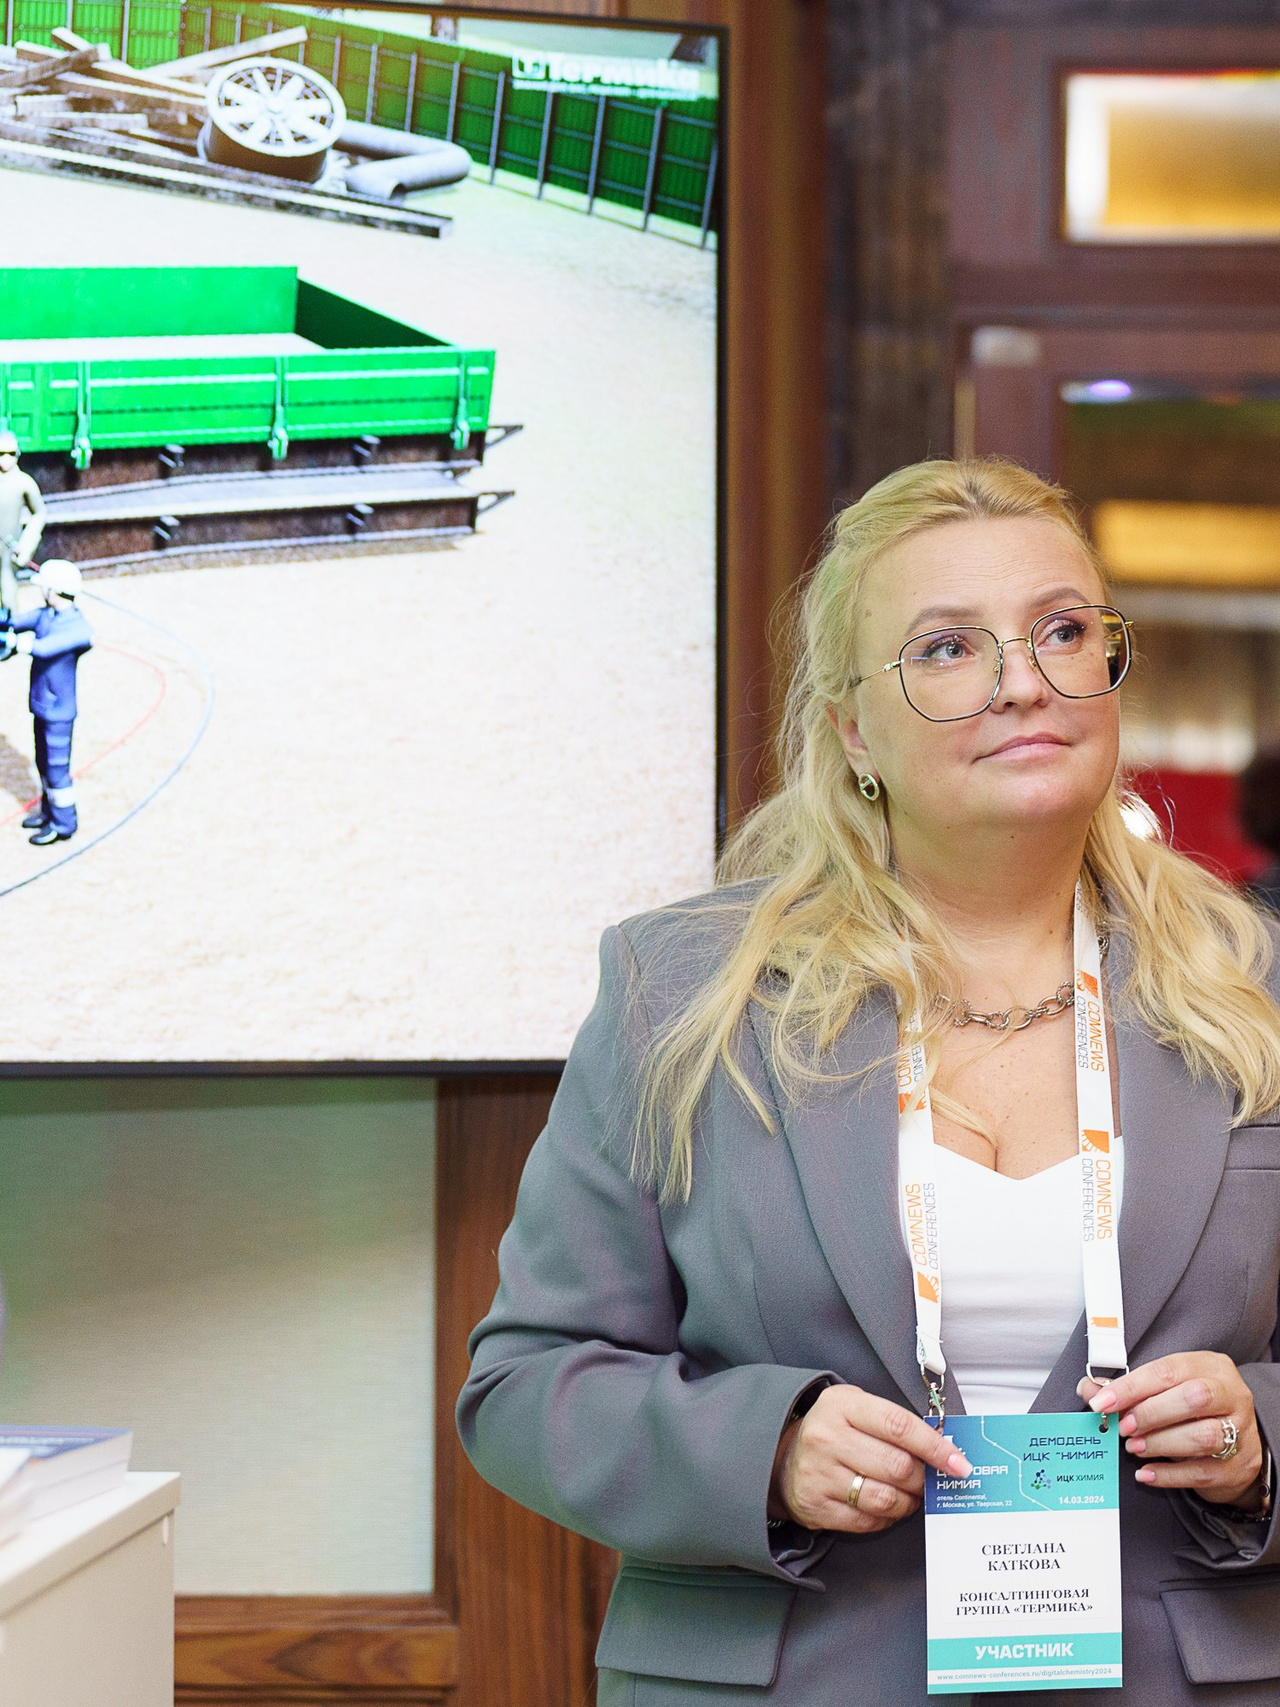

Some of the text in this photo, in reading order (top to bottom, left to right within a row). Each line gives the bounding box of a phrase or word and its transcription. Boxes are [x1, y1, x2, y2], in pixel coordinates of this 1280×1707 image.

[1076, 995, 1089, 1069] CONFERENCES
[1087, 1001, 1105, 1072] COMNEWS
[1081, 1158, 1095, 1242] CONFERENCES
[1095, 1159, 1112, 1240] COMNEWS
[905, 1183, 927, 1266] COMNEWS
[923, 1182, 939, 1270] CONFERENCES
[1029, 1436, 1102, 1448] ДЕМОДЕНЬ
[1023, 1452, 1050, 1462] ИЦК
[1056, 1473, 1105, 1483] ИЦК ХИМИЯ
[1059, 1495, 1105, 1505] 14.03.2024
[981, 1542, 1066, 1556] СВЕТЛАНА
[988, 1558, 1061, 1572] КАТКОВА
[959, 1588, 1090, 1603] КОНСАЛТИНГОВАЯ
[956, 1602, 1093, 1616] ГРУППА «ТЕРМИКА»
[975, 1642, 1074, 1660] УЧАСТНИК
[937, 1667, 1112, 1681] www.comnews-conferences.ru/digitalchemistry2024
